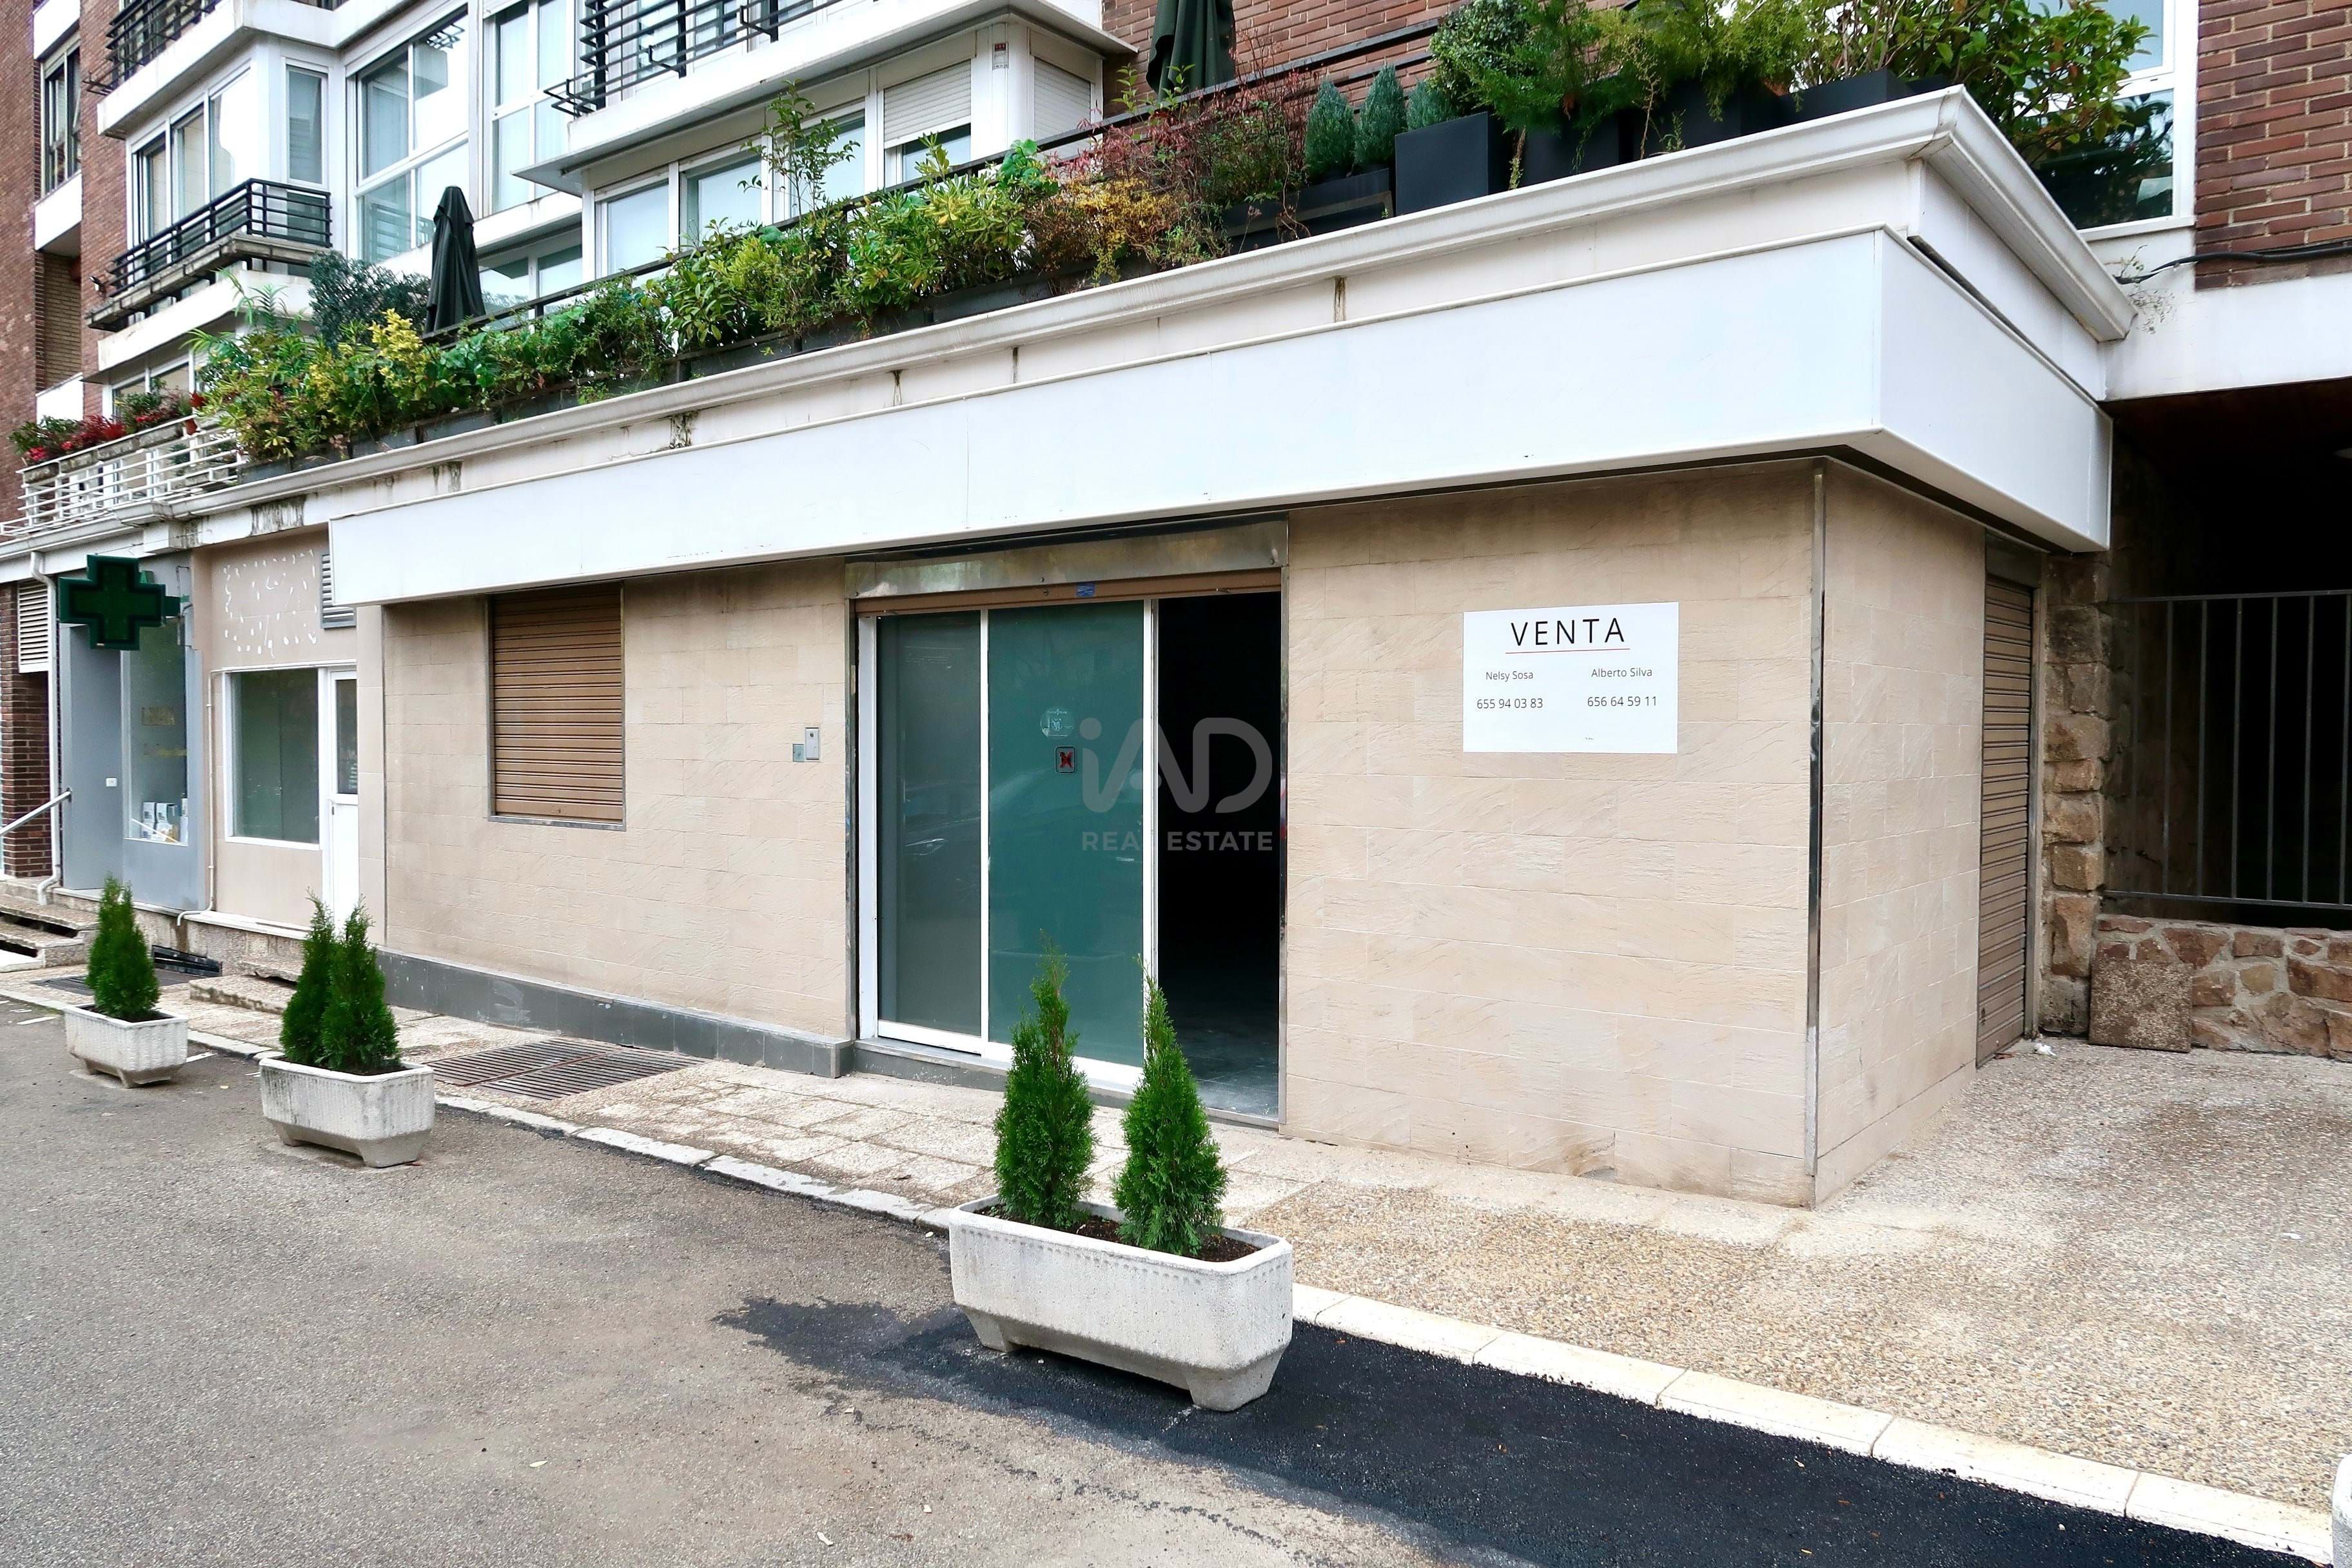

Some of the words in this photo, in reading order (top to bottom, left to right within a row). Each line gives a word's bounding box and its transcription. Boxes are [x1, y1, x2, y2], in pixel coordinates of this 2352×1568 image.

[1511, 618, 1625, 646] VENTA
[1485, 671, 1509, 682] Nelsy
[1513, 671, 1534, 680] Sosa
[1591, 668, 1627, 677] Alberto
[1630, 667, 1652, 677] Silva
[1476, 699, 1496, 709] 655
[1498, 698, 1512, 709] 94
[1514, 698, 1527, 709] 03
[1530, 698, 1544, 709] 83
[1587, 696, 1607, 707] 656
[1611, 696, 1624, 707] 64
[1627, 696, 1641, 707] 59
[1645, 696, 1657, 706] 11
